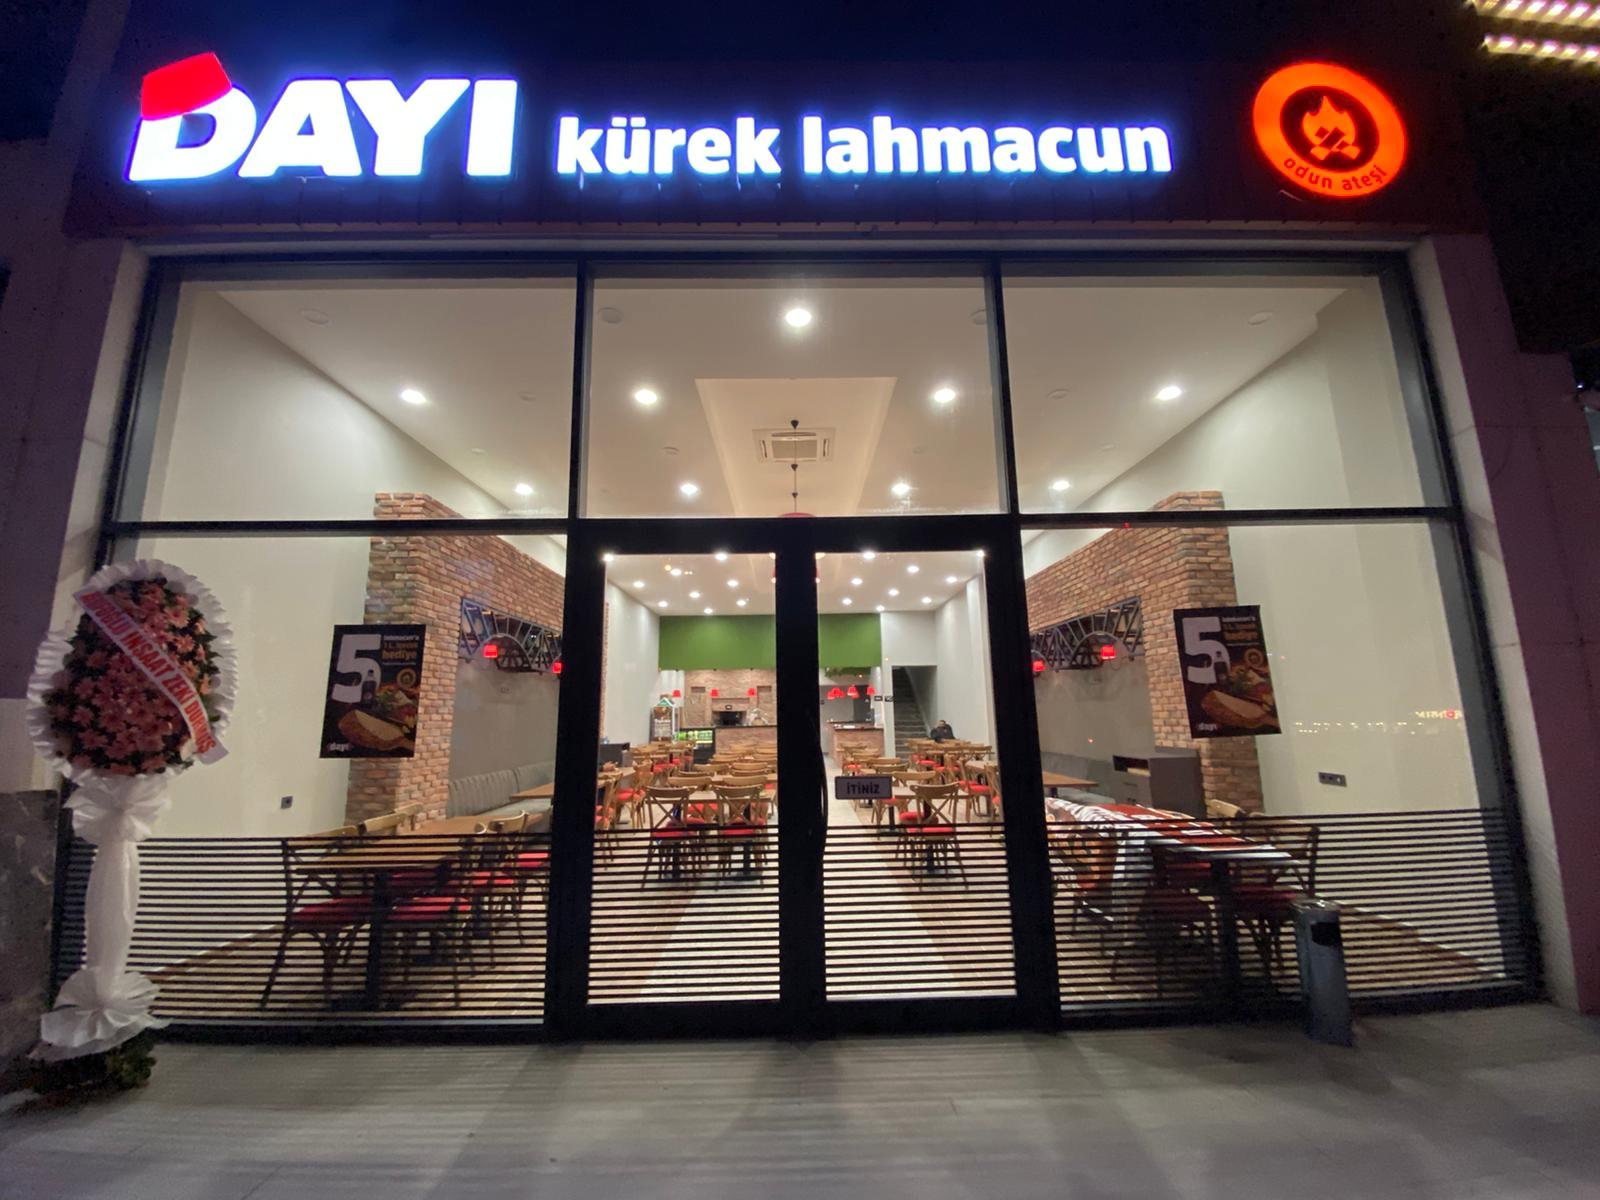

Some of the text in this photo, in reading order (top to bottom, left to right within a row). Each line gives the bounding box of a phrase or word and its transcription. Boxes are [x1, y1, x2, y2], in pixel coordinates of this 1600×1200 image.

[130, 79, 517, 180] DAYI
[557, 116, 1171, 174] kürek lahmacun
[1284, 158, 1387, 190] odun ateşi
[332, 634, 382, 703] 5
[1182, 616, 1230, 684] 5
[847, 781, 880, 794] İTİNİZ
